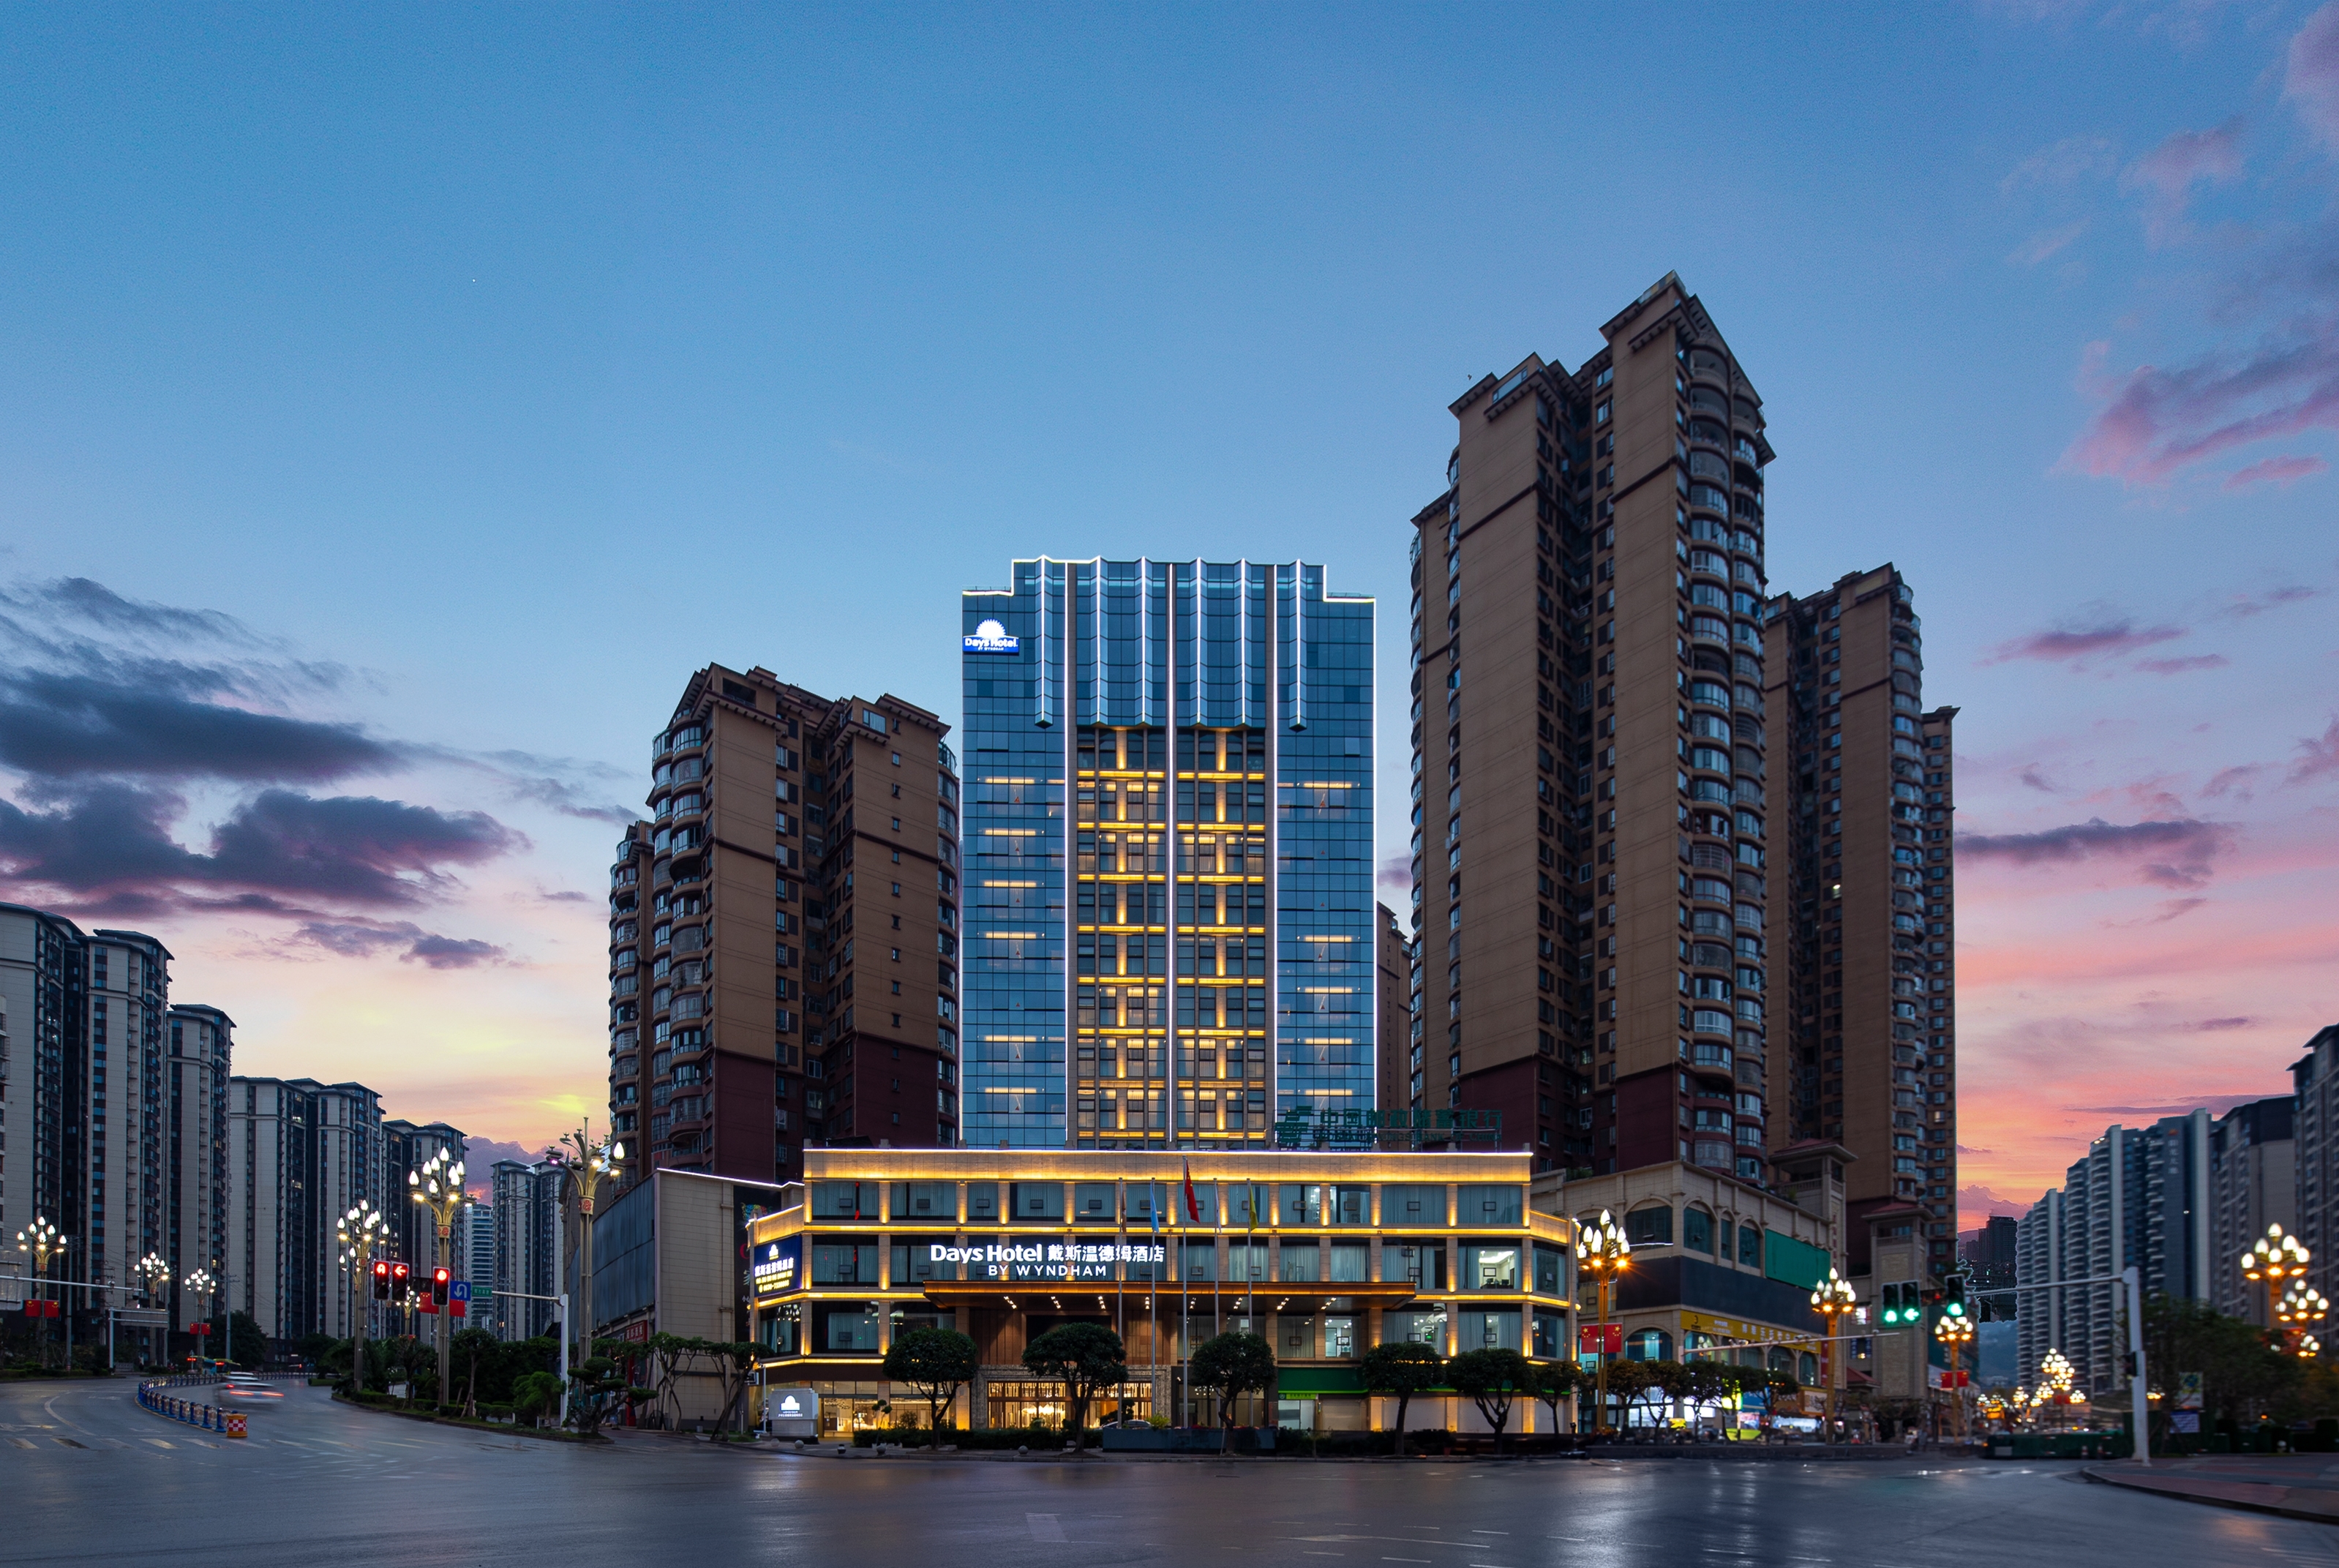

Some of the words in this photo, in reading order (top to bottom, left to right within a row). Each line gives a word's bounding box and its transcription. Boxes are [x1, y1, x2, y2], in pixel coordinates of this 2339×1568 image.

[964, 638, 991, 648] Days
[991, 637, 1018, 648] Hotel
[1320, 1107, 1502, 1129] 中国邮政储蓄银行
[1416, 1133, 1445, 1141] BANK
[1451, 1133, 1463, 1141] OF
[1469, 1133, 1502, 1141] CHINA
[930, 1245, 984, 1264] Days
[987, 1244, 1043, 1262] Hotel
[1048, 1244, 1165, 1263] 戴斯温德姆酒店
[988, 1264, 1008, 1276] BY
[1015, 1264, 1106, 1276] WYNDHAM
